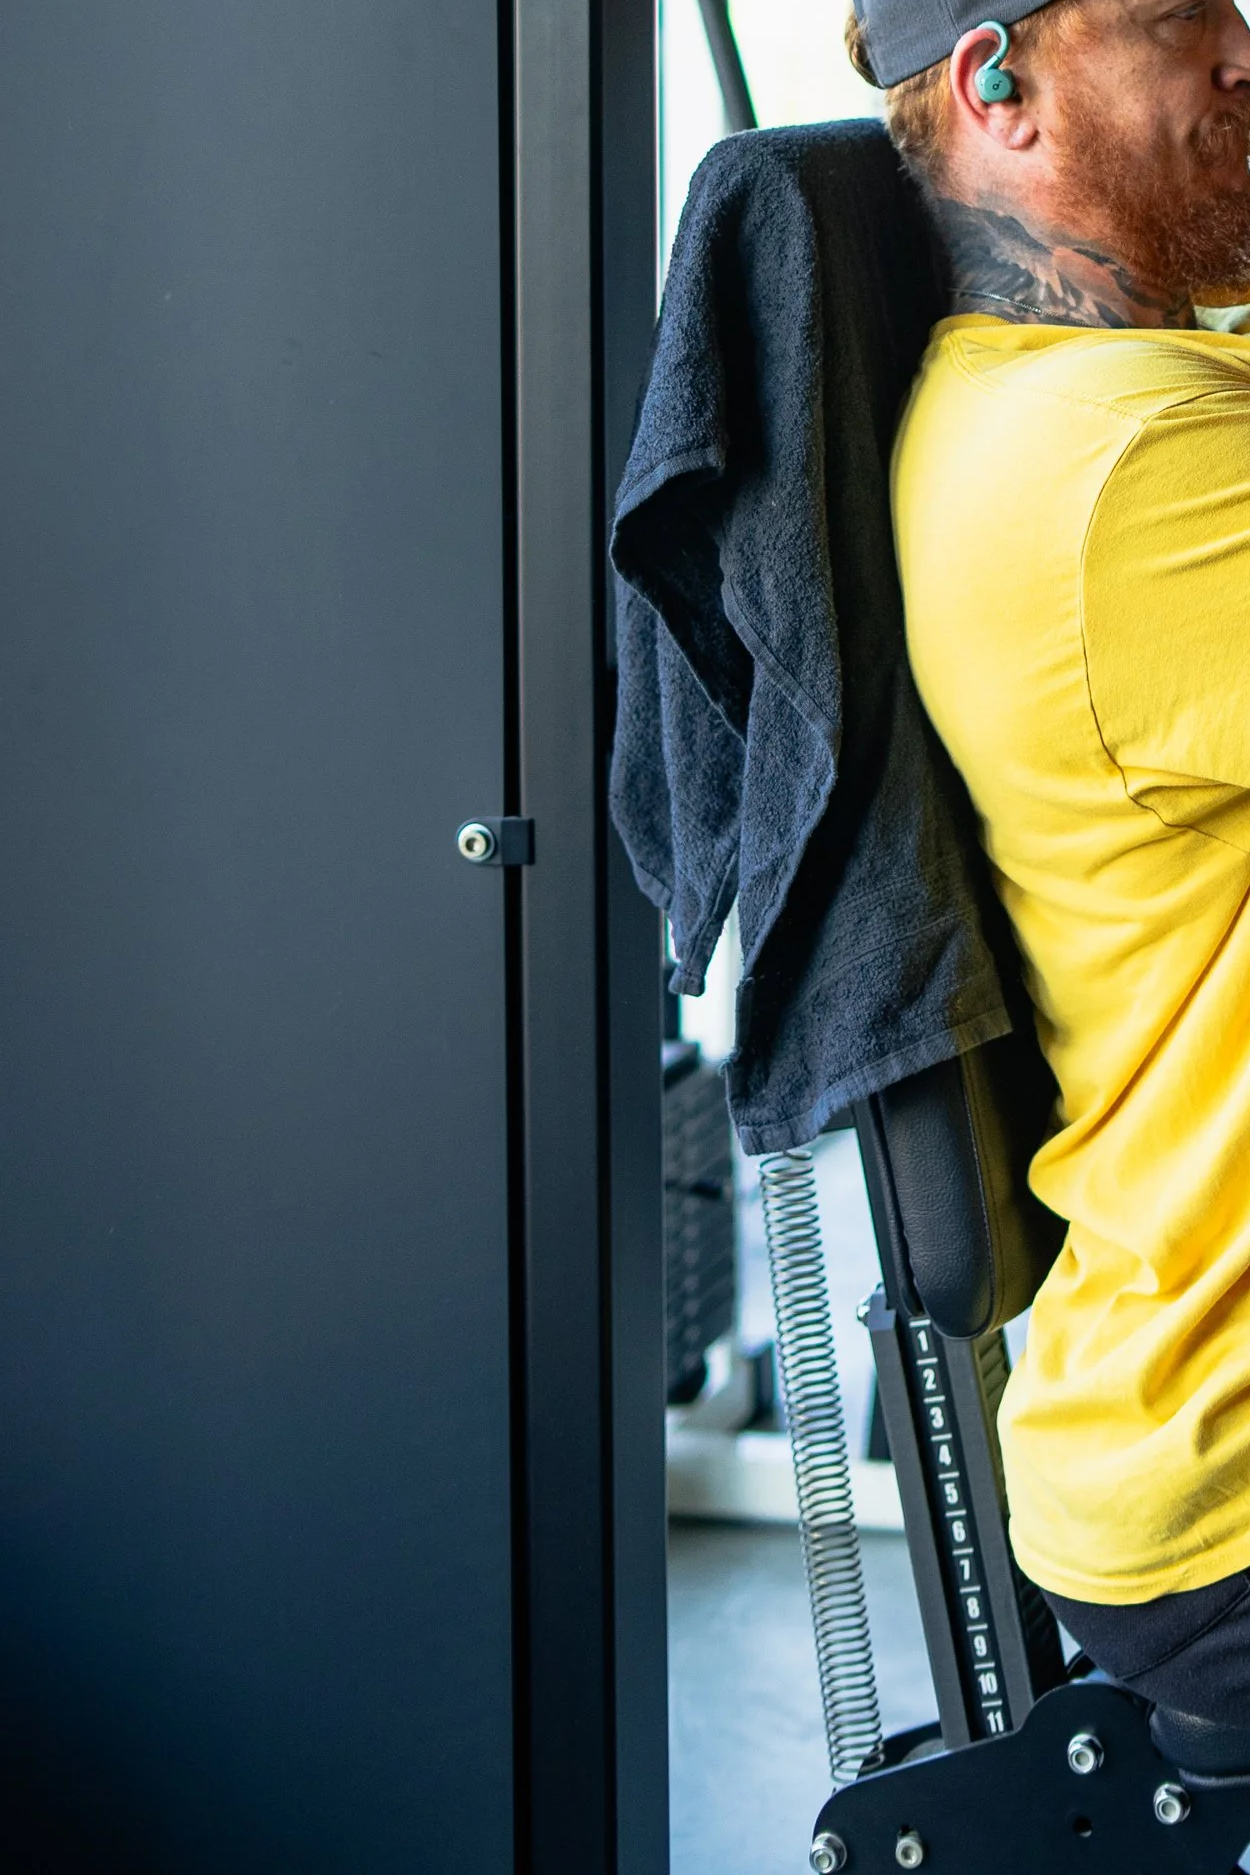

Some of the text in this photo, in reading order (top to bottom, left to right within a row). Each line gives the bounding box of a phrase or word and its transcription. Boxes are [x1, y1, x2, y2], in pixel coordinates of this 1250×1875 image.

[917, 1329, 929, 1353] 1
[922, 1368, 937, 1391] 2
[929, 1406, 945, 1429] 3
[938, 1444, 952, 1466] 4
[944, 1482, 959, 1505] 5
[951, 1520, 966, 1543] 6
[958, 1558, 970, 1581] 7
[966, 1596, 981, 1619] 8
[973, 1635, 987, 1657] 9
[978, 1672, 998, 1695] 10
[986, 1710, 1004, 1734] 11
